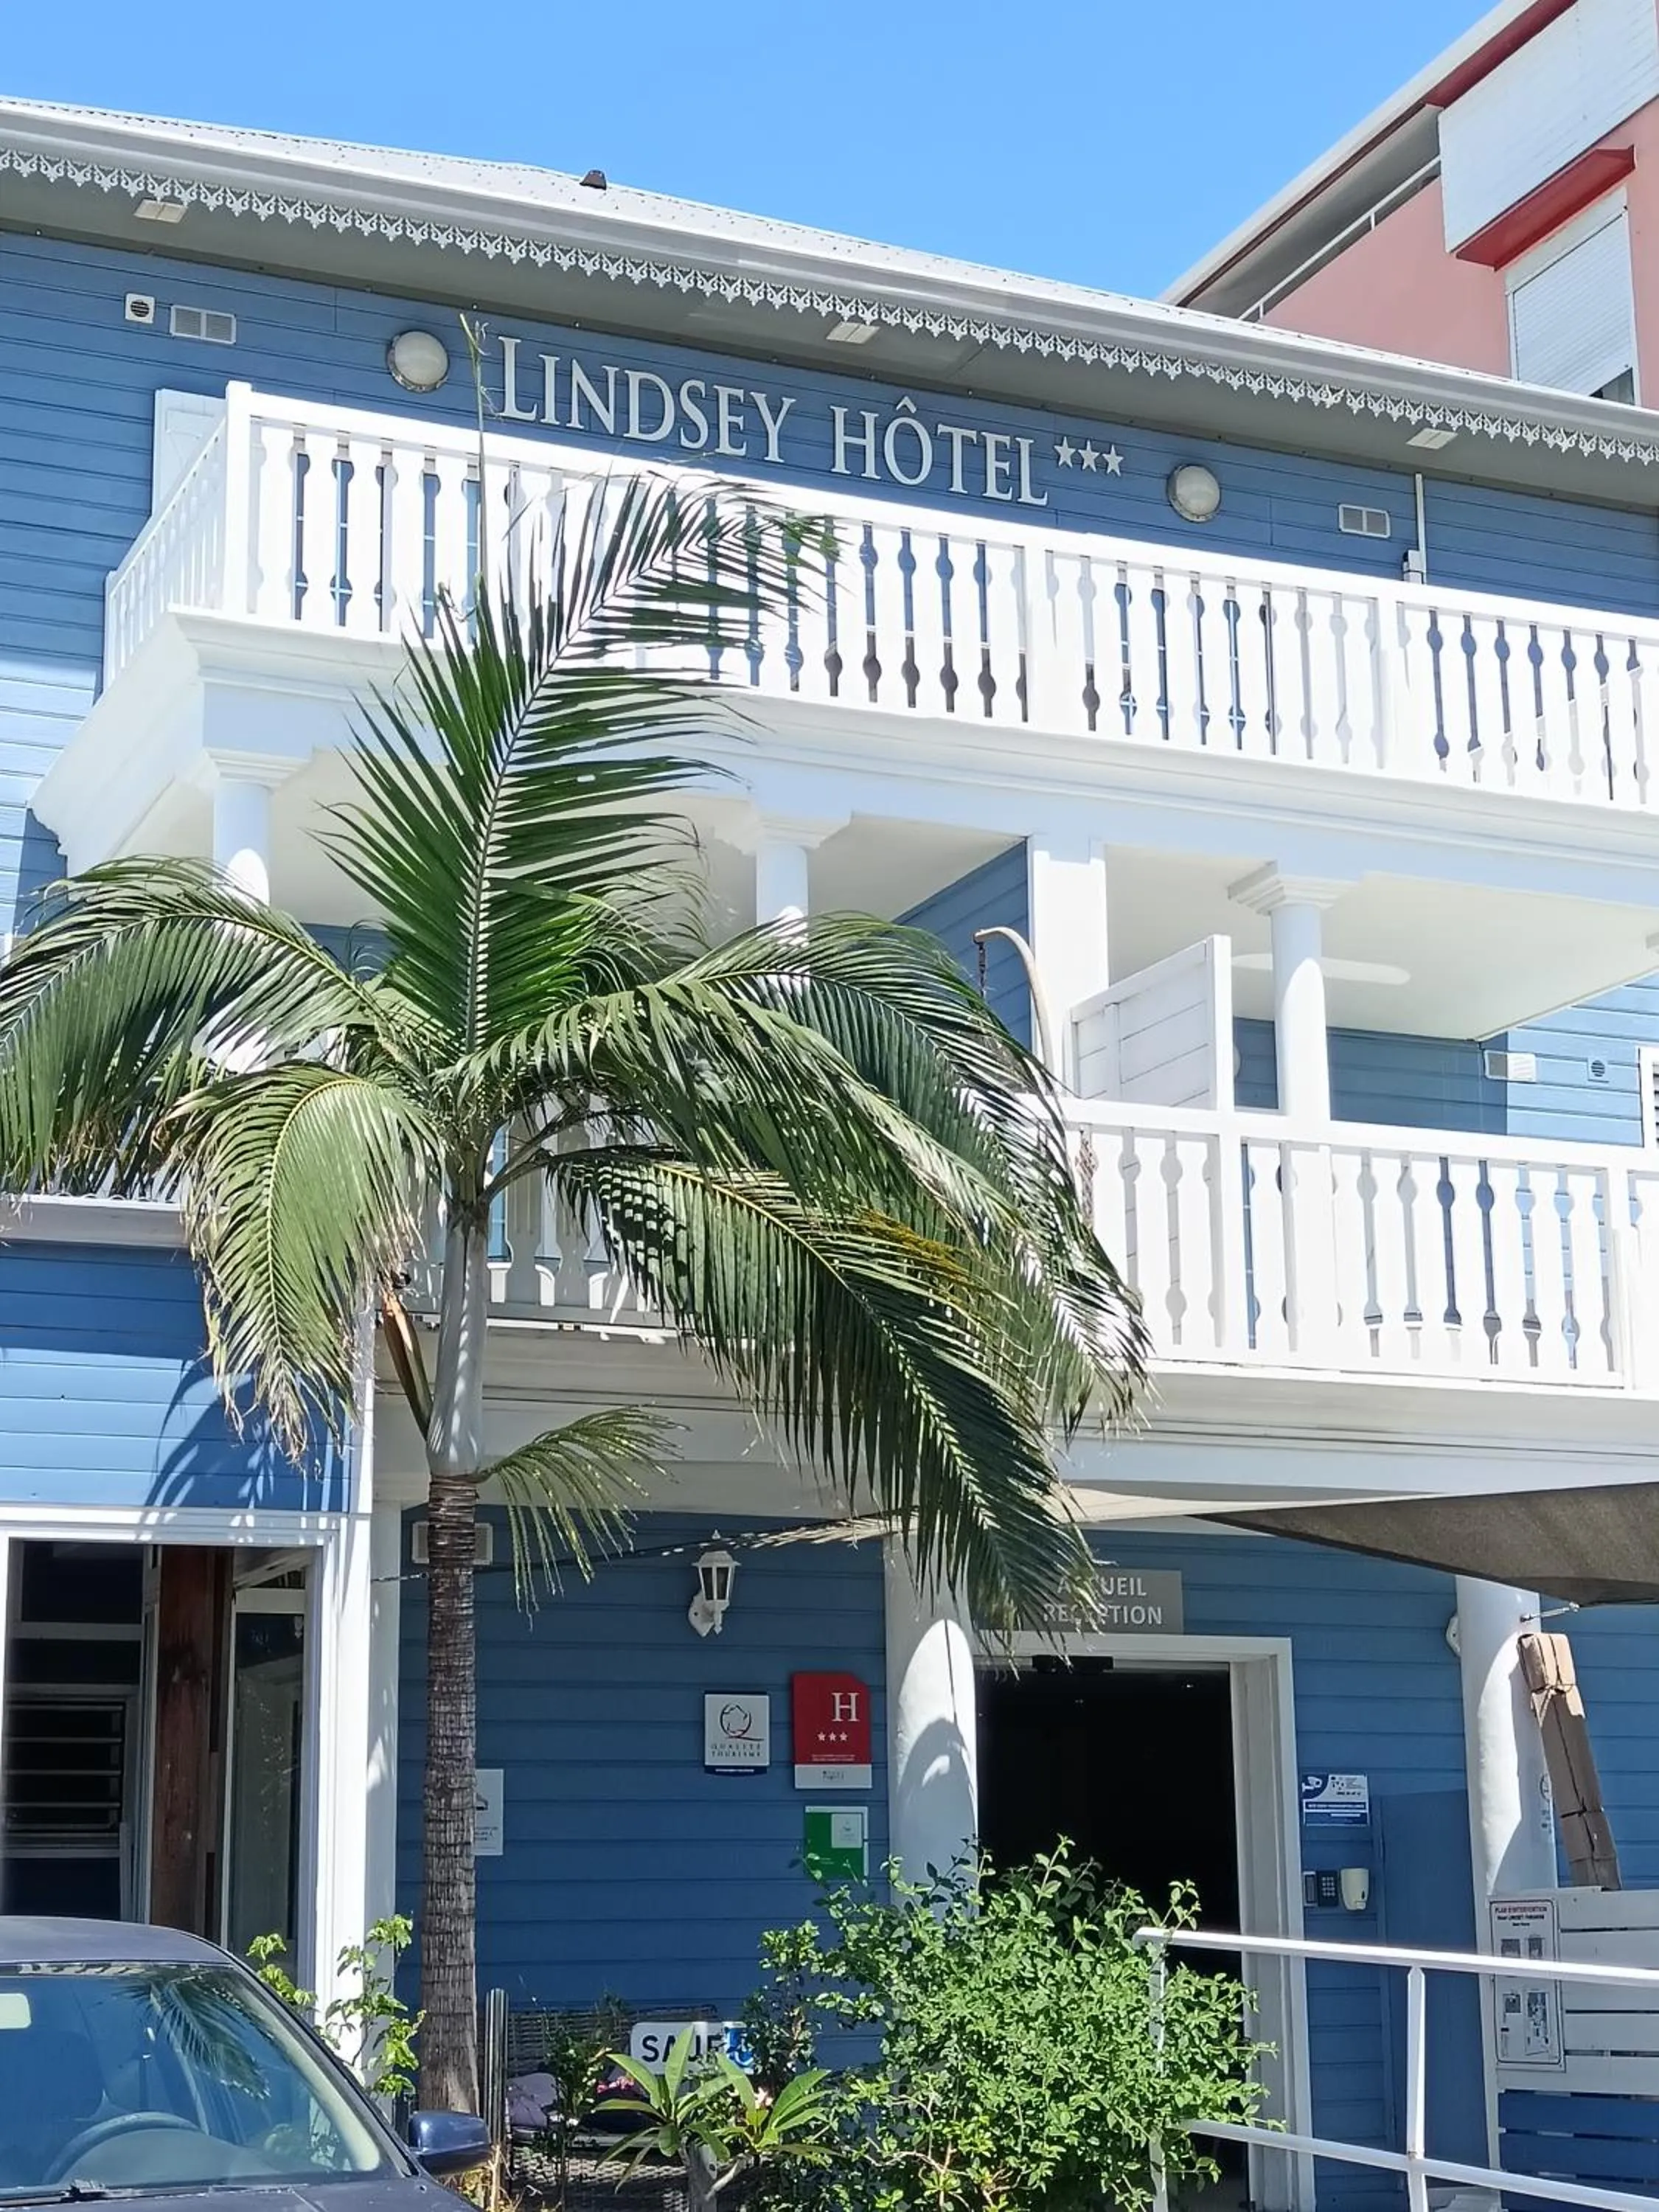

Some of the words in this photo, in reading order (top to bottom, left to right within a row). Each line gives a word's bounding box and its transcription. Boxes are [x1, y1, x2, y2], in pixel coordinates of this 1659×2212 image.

[498, 335, 797, 463] LINDSEY
[830, 395, 1048, 507] HÔTEL
[1057, 1575, 1147, 1596] AUEIL
[831, 1692, 861, 1722] H
